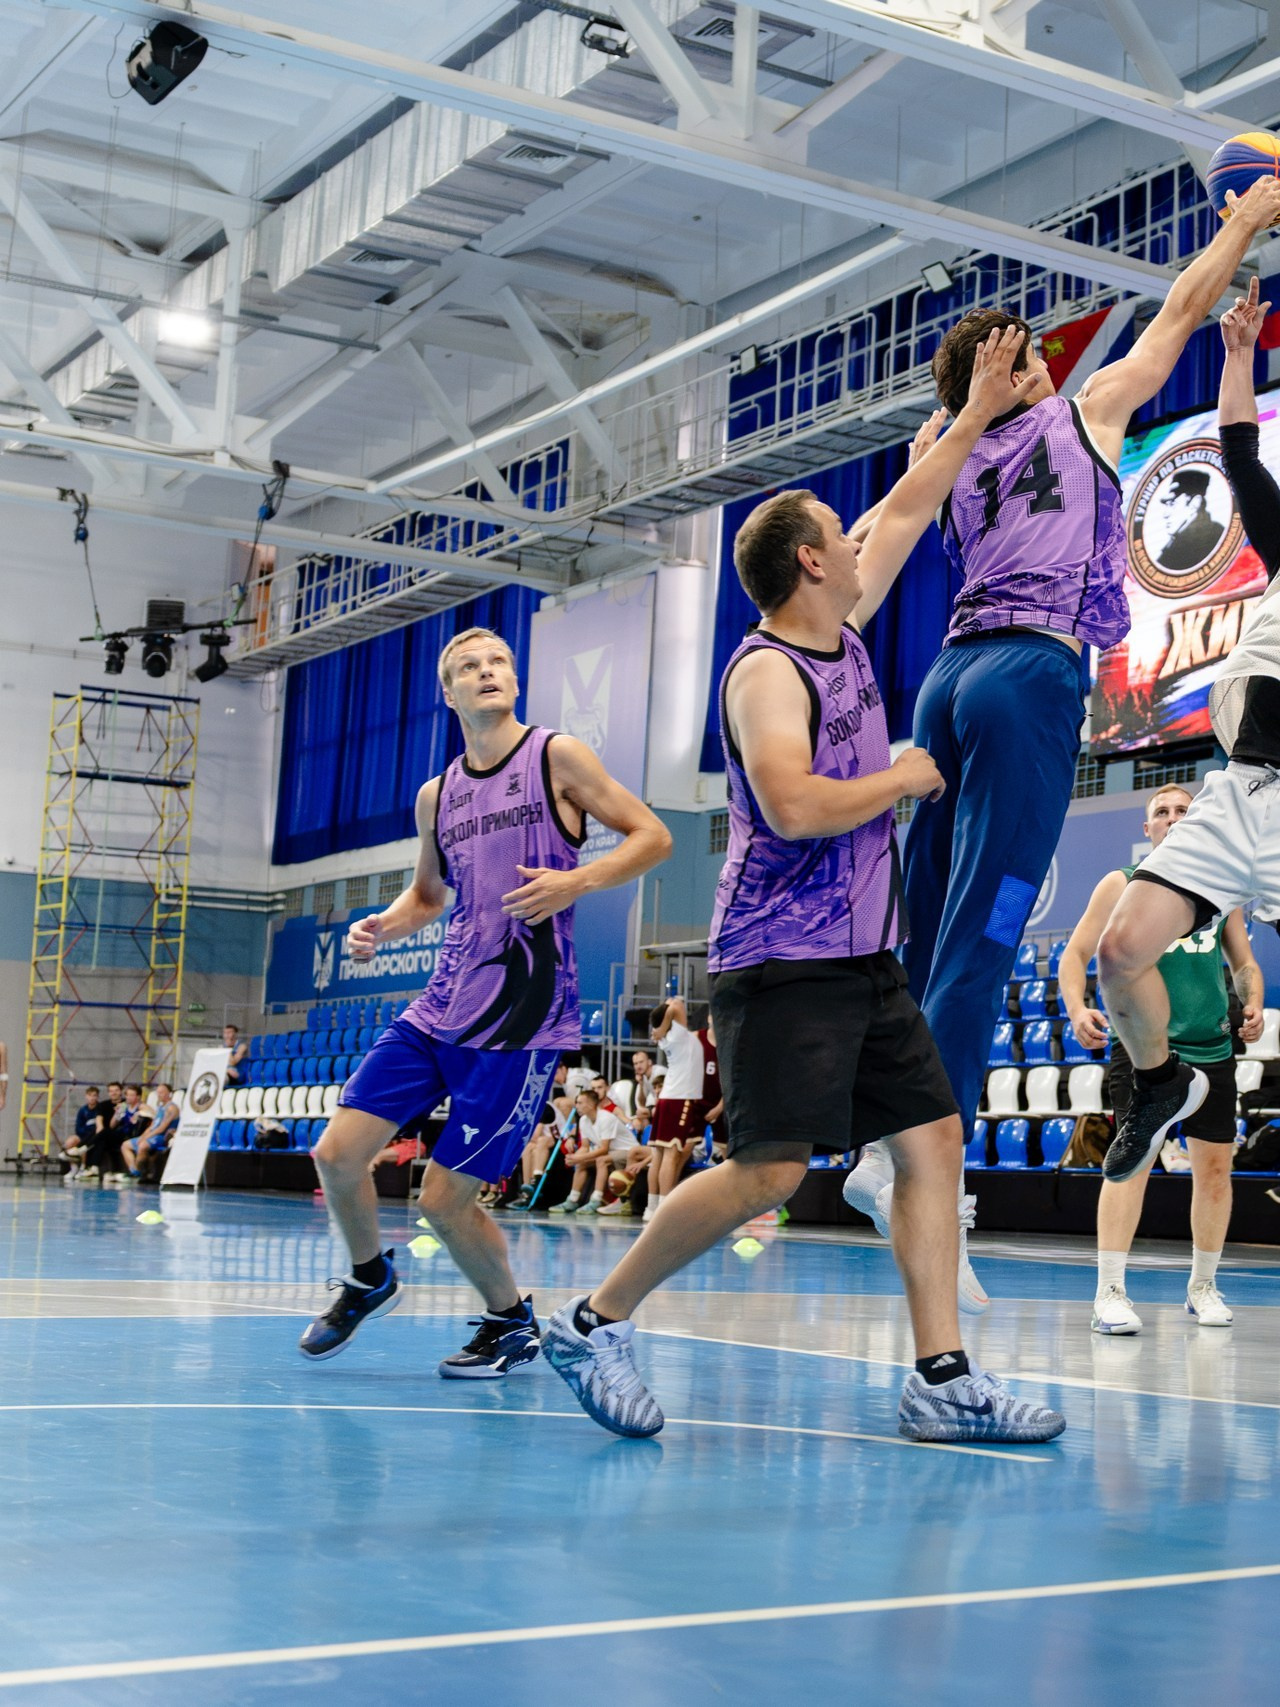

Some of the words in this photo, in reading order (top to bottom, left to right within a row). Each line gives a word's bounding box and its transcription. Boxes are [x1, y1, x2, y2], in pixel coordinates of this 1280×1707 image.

[973, 432, 1066, 531] 14
[1159, 461, 1175, 478] ПО
[481, 801, 543, 836] ПРИМОРЬЯ
[338, 949, 432, 981] ПРИМОРСКОГО
[705, 1061, 717, 1075] 6
